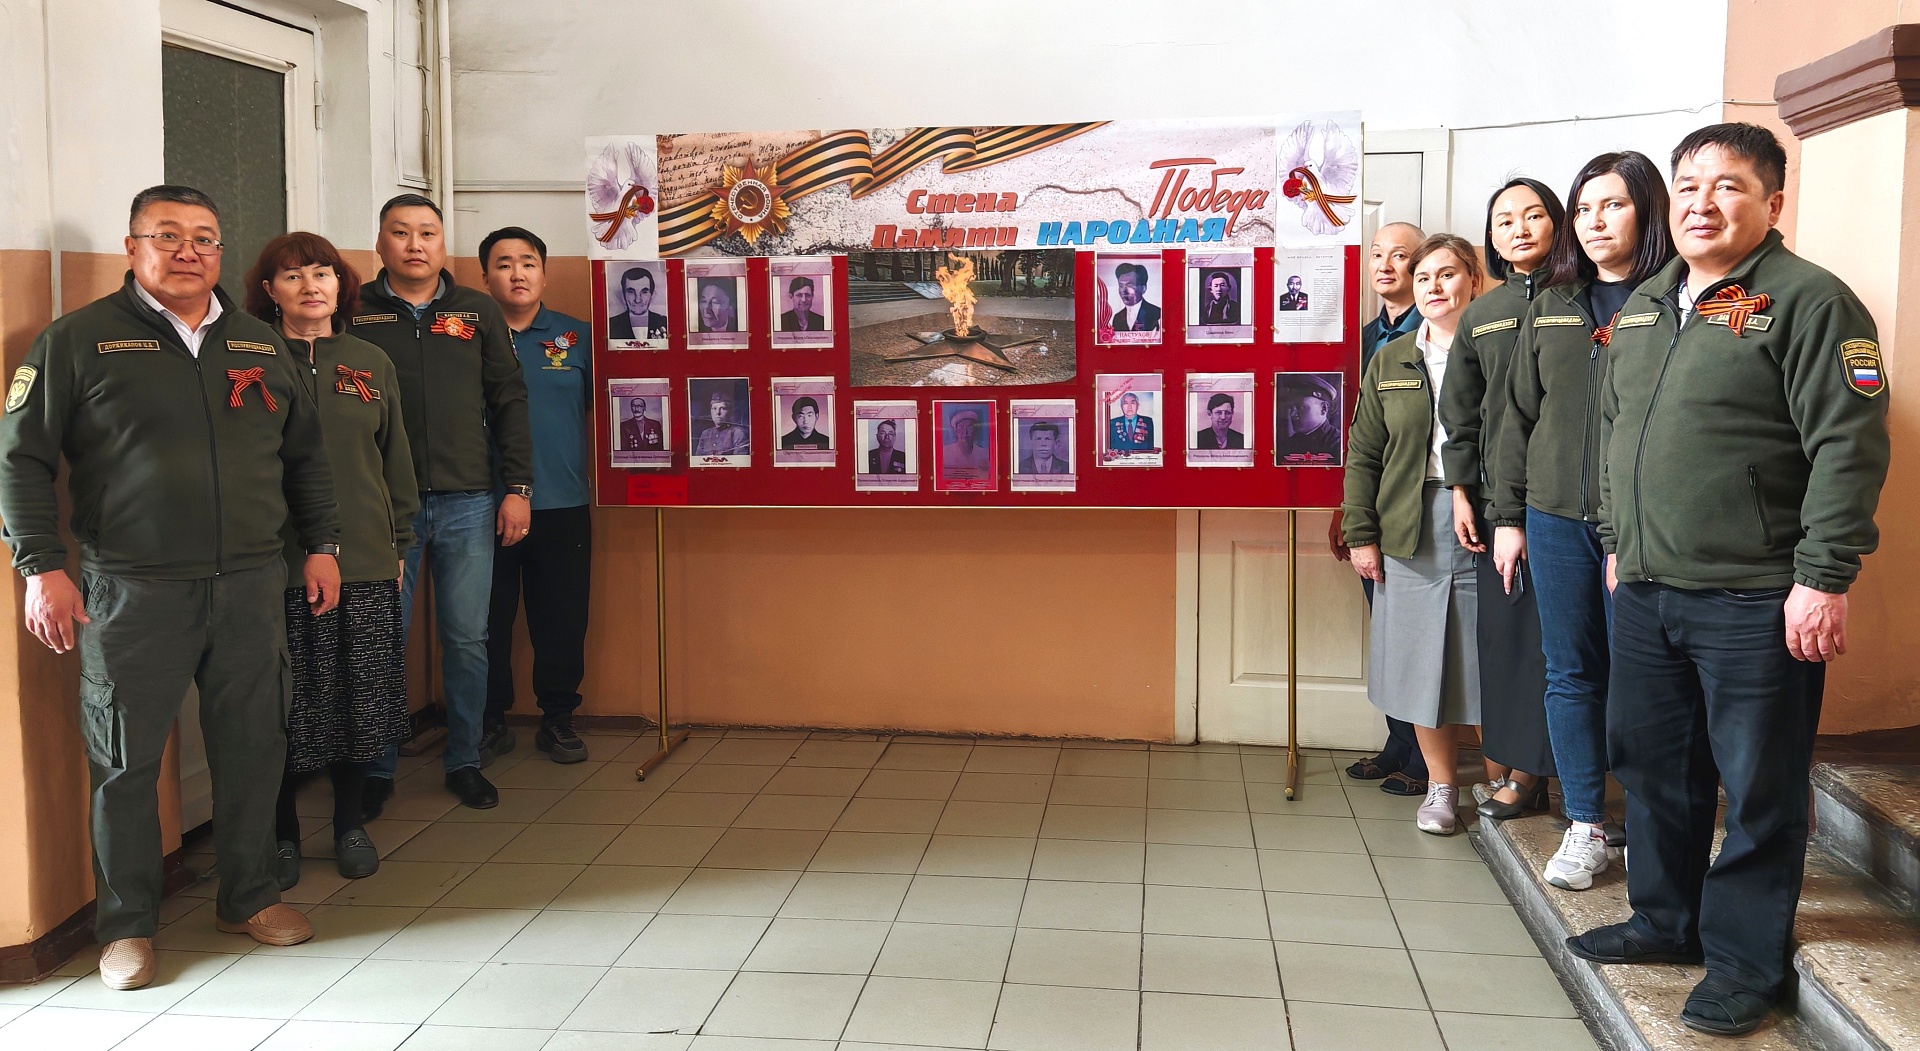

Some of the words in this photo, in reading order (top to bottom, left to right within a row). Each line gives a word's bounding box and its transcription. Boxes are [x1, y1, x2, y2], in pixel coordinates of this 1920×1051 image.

[730, 181, 767, 220] ОТЕЧЕСТВЕННАЯ
[758, 193, 770, 219] ВОЙНА
[905, 189, 1019, 214] Стена
[1149, 157, 1270, 237] Победа
[871, 224, 1019, 249] Памяти
[1036, 217, 1227, 246] НАРОДНАЯ
[1850, 359, 1876, 367] РОССИЯ
